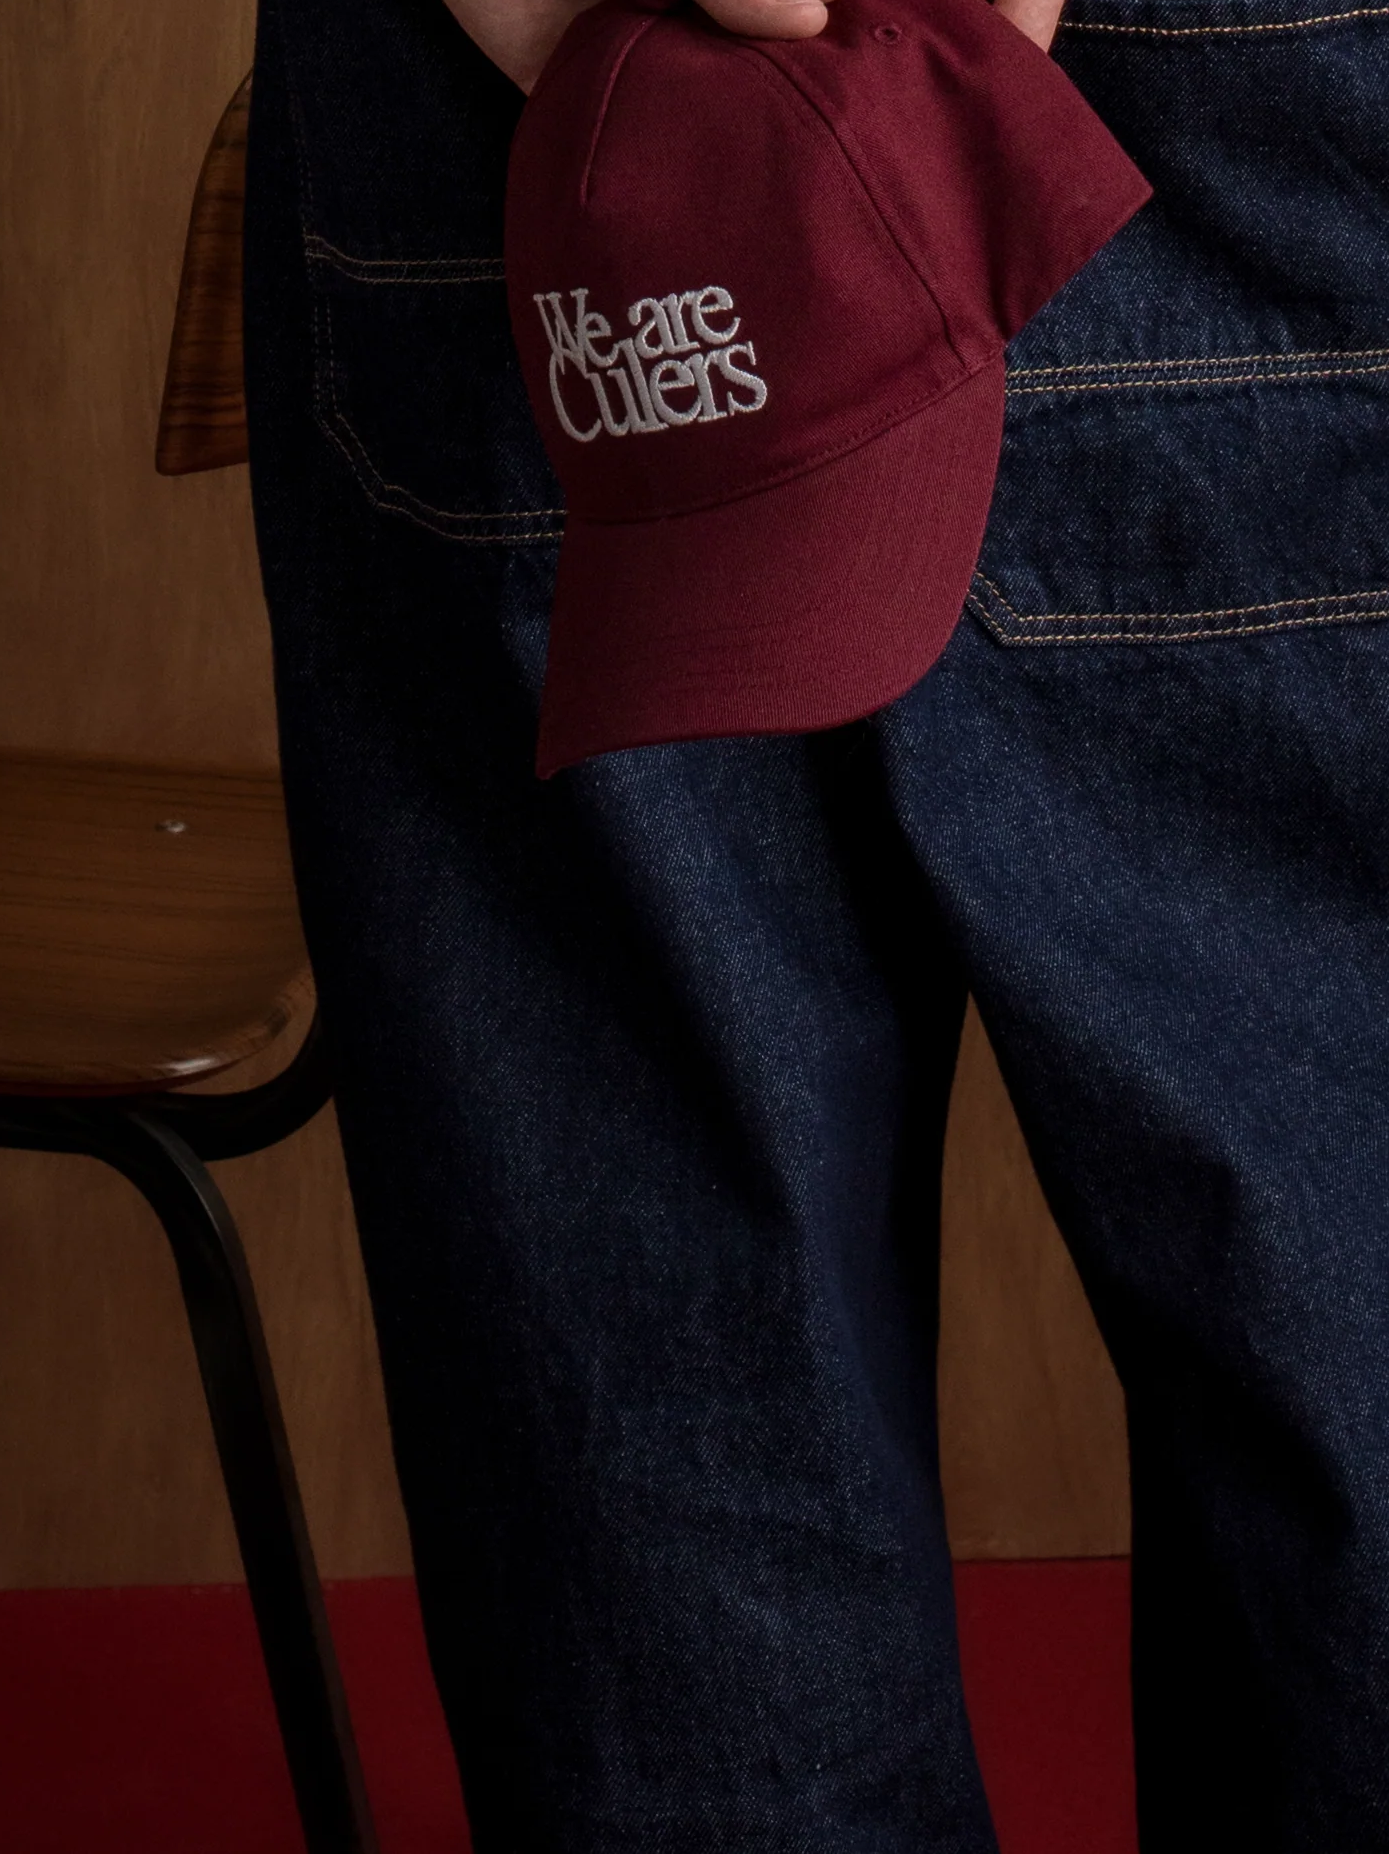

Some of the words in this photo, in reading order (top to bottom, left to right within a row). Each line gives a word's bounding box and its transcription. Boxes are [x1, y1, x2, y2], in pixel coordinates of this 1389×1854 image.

[532, 287, 612, 379] We
[627, 285, 741, 359] are
[548, 337, 768, 443] Culers
